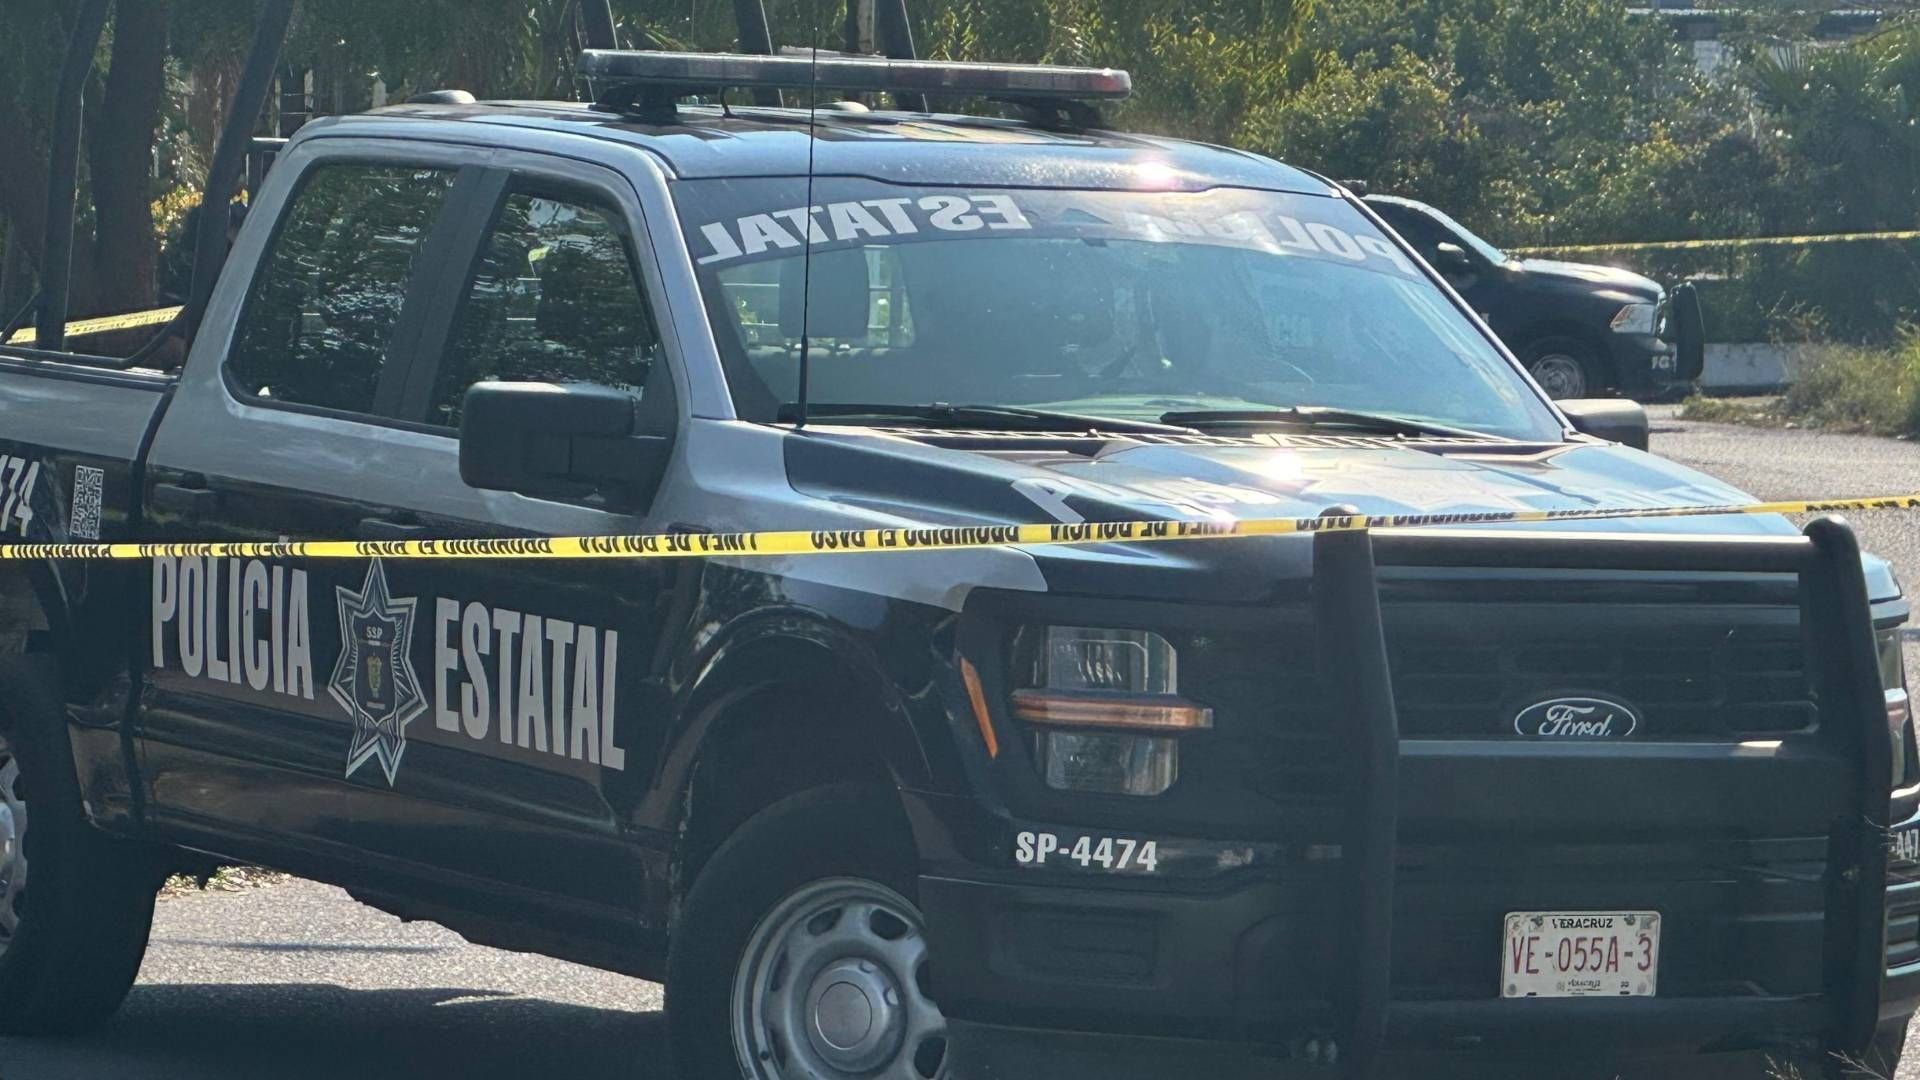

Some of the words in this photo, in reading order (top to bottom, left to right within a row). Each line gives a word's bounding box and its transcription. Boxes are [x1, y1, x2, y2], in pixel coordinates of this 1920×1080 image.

[153, 556, 314, 700] POLICIA
[435, 597, 625, 771] ESTATAL
[1538, 704, 1614, 737] Ford
[1015, 831, 1158, 872] SP-4474
[1552, 918, 1614, 929] VERACRUZ
[1512, 935, 1653, 975] VE-055A-3
